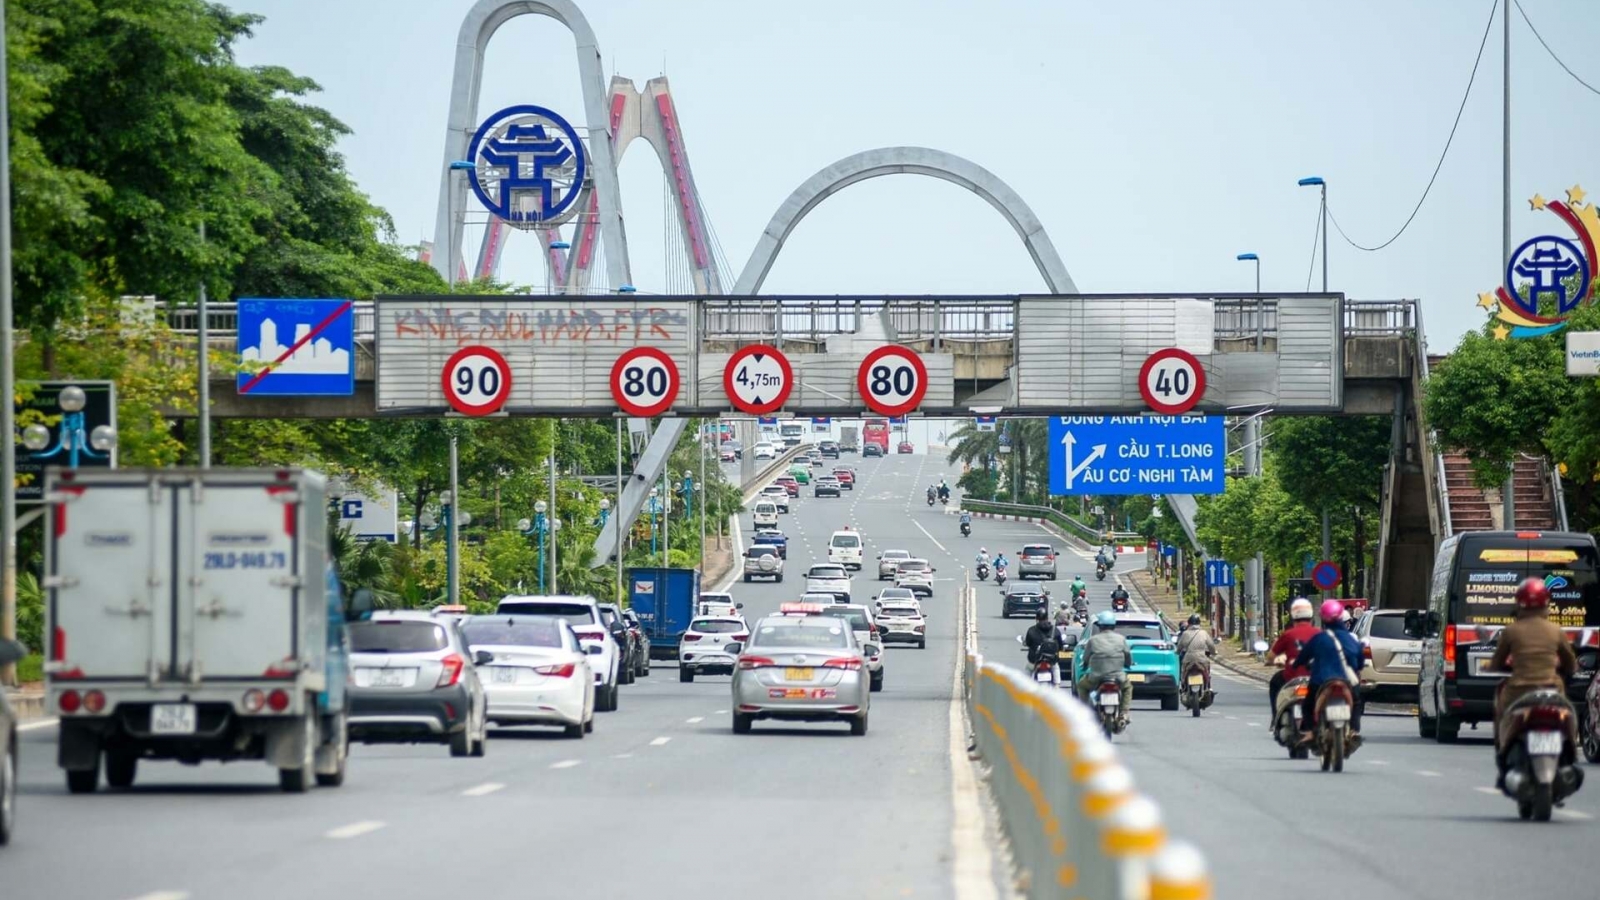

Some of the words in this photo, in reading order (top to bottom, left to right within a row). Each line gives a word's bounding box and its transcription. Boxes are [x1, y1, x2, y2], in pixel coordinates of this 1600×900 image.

[1570, 349, 1600, 358] VietinB
[456, 366, 499, 396] 90
[624, 366, 667, 397] 80
[736, 365, 781, 390] 4,75m
[870, 365, 915, 396] 80
[1155, 368, 1189, 397] 40
[1118, 437, 1150, 458] CẦU
[1083, 465, 1104, 483] ÂU
[1180, 465, 1213, 482] TÀM
[1466, 584, 1519, 594] LIMOUSIN
